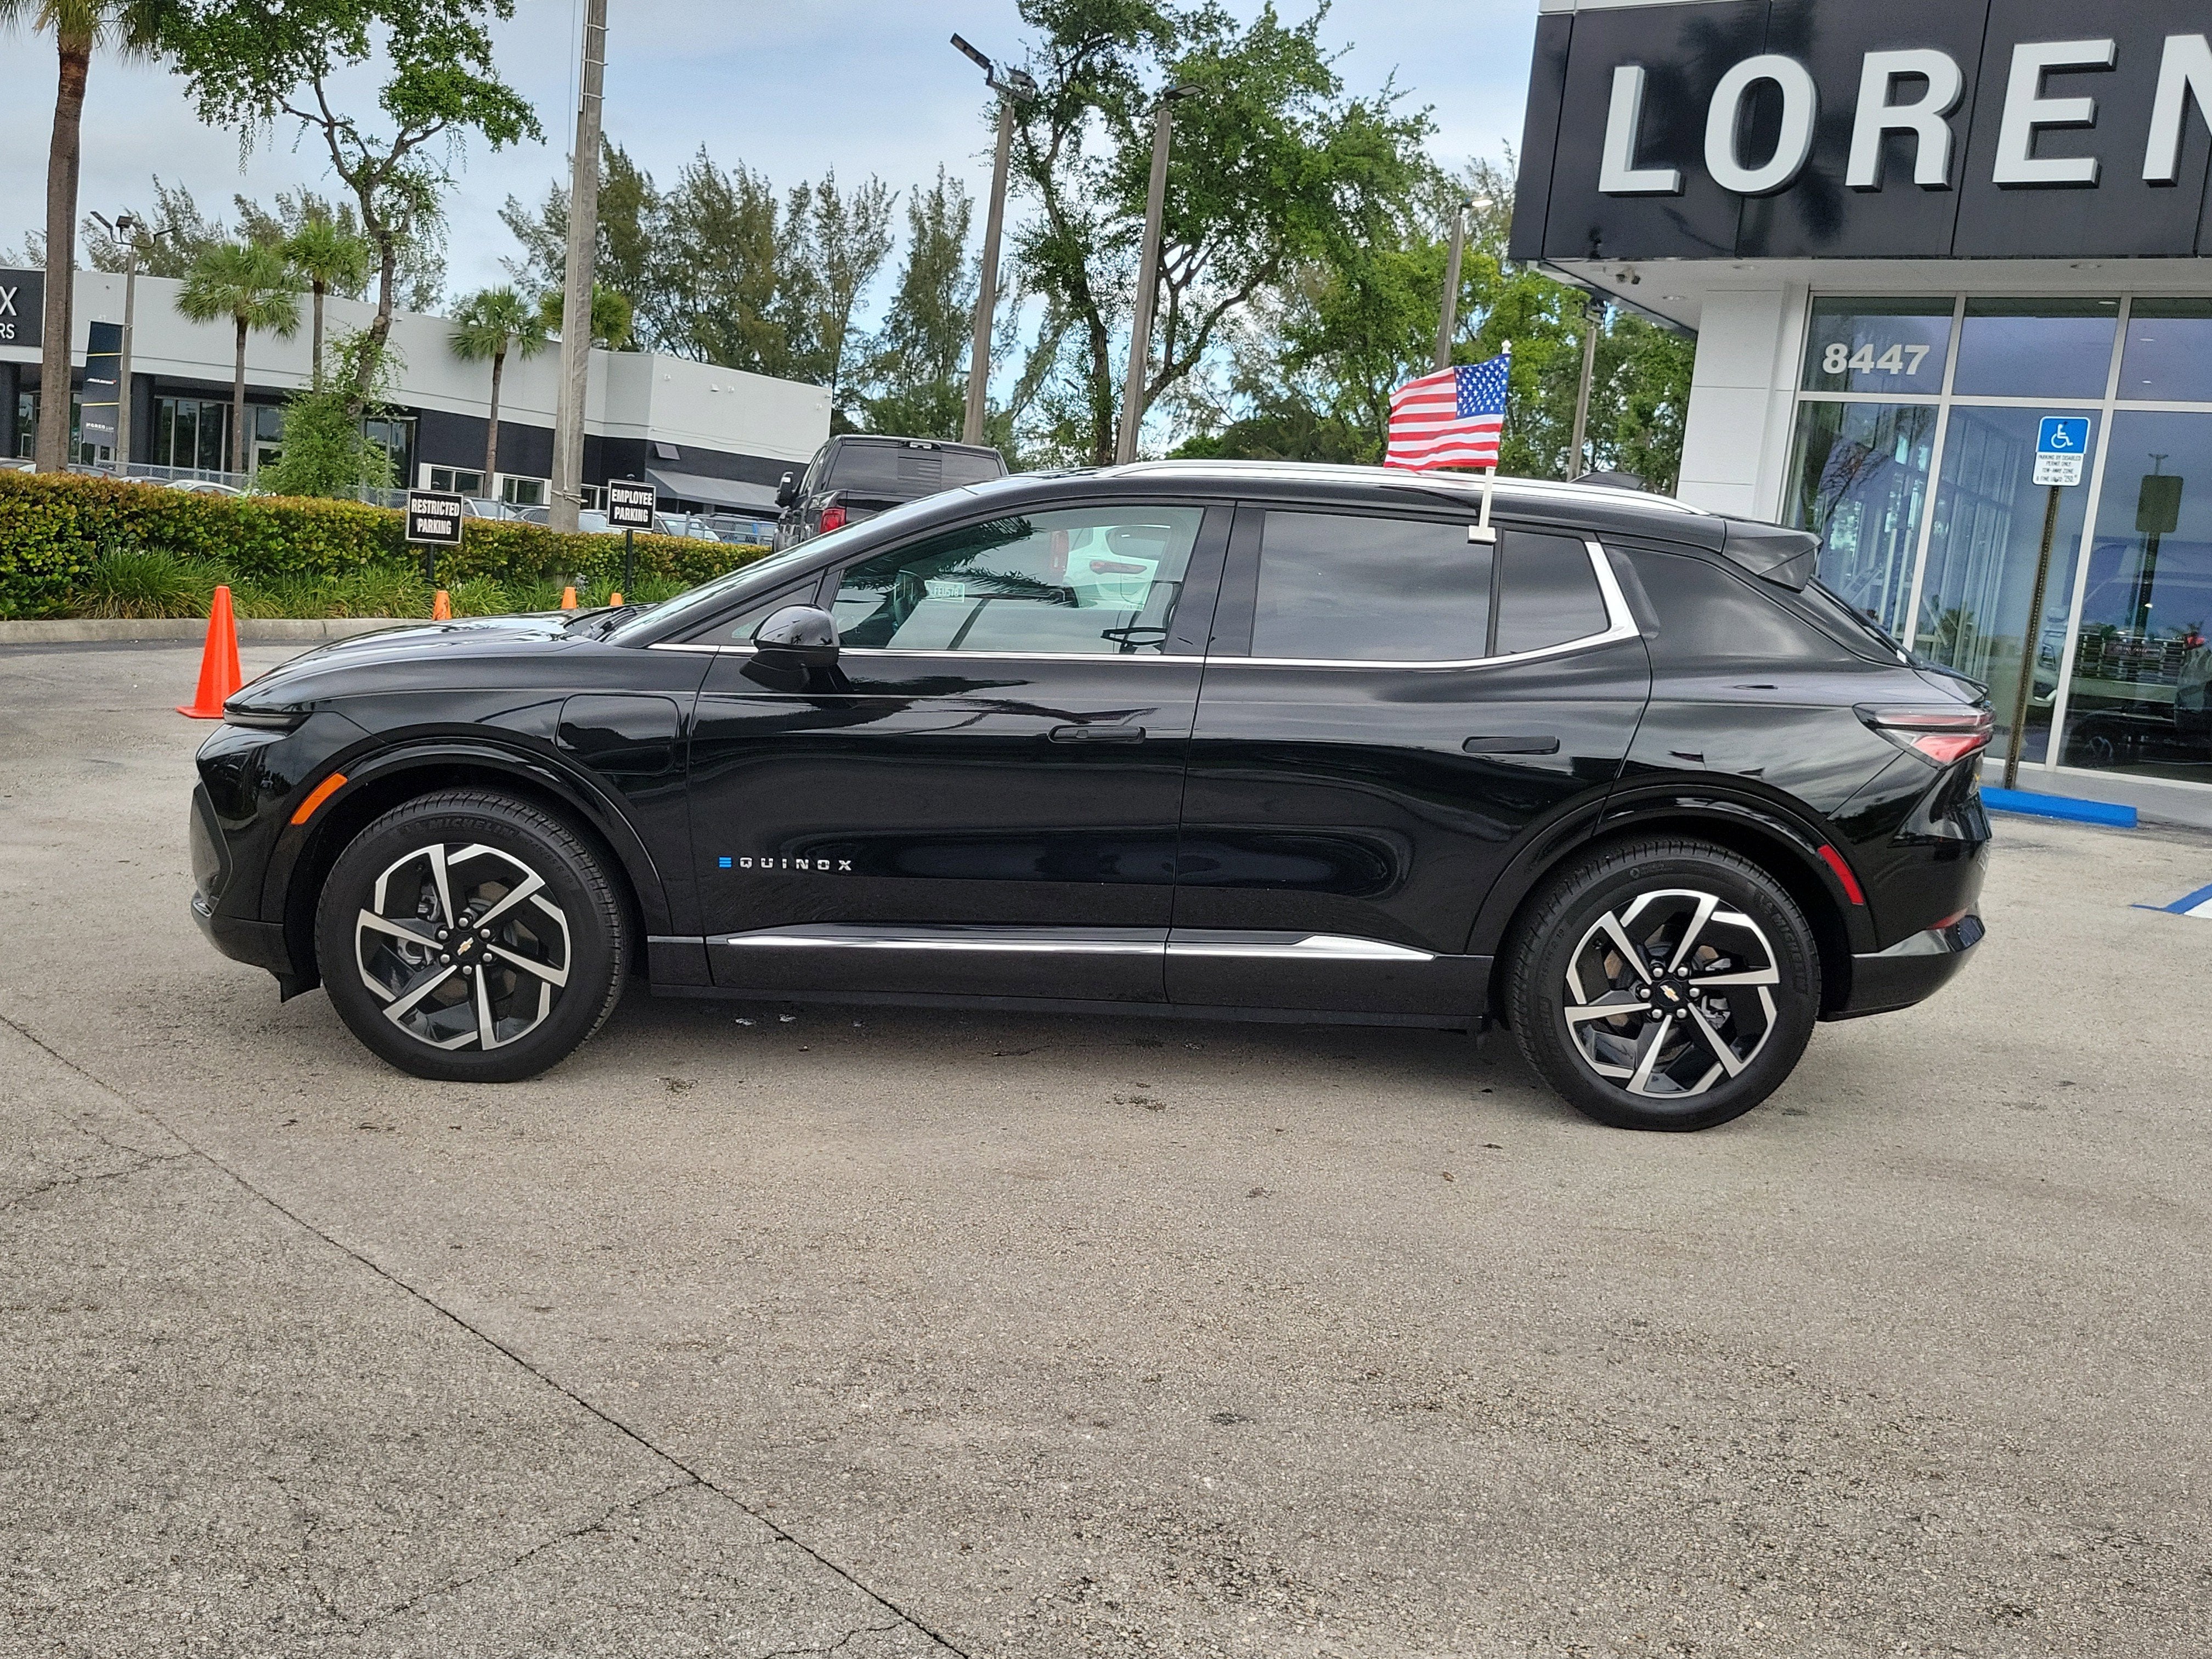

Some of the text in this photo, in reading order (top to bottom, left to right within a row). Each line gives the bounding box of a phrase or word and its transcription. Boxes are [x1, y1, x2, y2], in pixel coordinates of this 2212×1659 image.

[1822, 343, 1929, 375] 8447
[612, 488, 653, 506] EMPLOYEE
[411, 498, 460, 517] RESTRICTED
[614, 506, 648, 522] PARKING
[417, 518, 452, 535] PARKING
